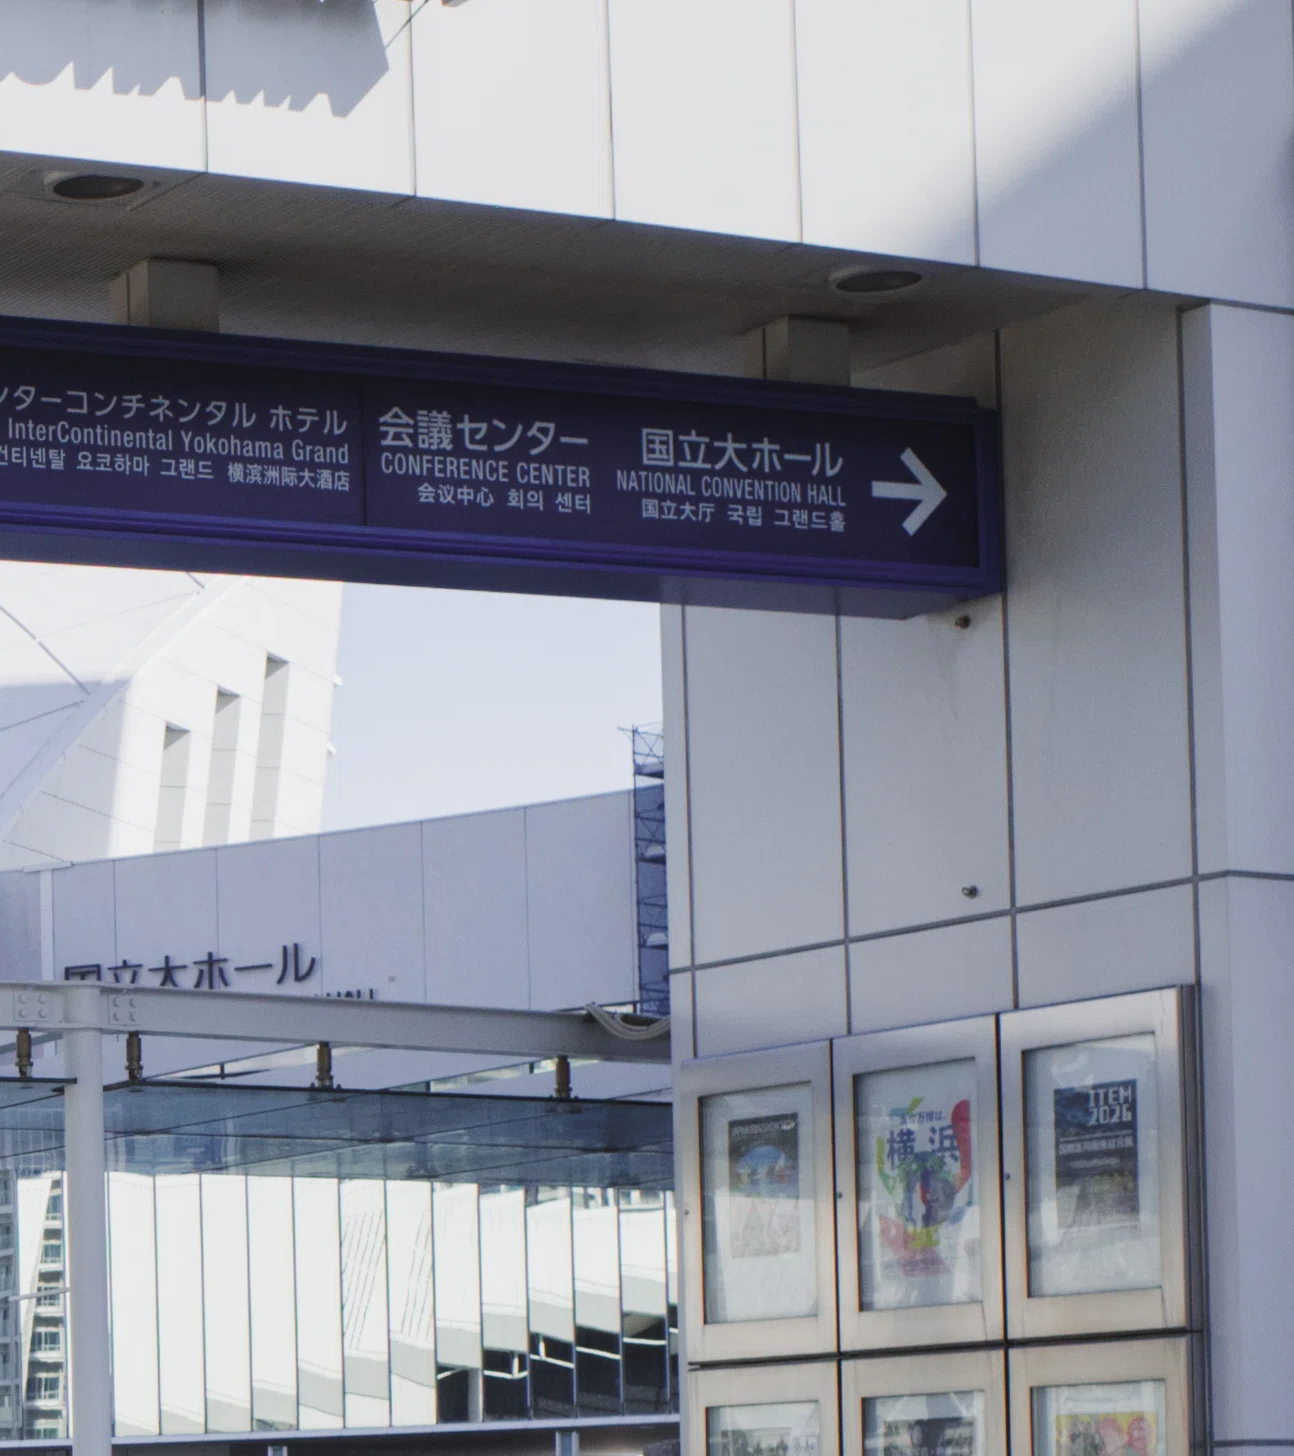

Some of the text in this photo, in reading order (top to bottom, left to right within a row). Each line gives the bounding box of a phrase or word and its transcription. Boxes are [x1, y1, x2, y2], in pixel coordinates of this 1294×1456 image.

[269, 405, 348, 436] ホテル
[379, 406, 588, 456] 会議センター
[8, 417, 349, 465] InterContinental Yokohama Grand
[641, 427, 844, 478] 国立大ホール
[76, 451, 150, 477] 요코하마
[160, 458, 214, 480] 그랜드
[381, 452, 590, 488] CONFERENCE CENTER
[417, 482, 591, 515] 会议中心 회의 센터
[616, 469, 846, 507] NATIONAL CONVENTION HALL
[641, 498, 716, 523] 国立大厅
[1089, 1085, 1132, 1107] ITEM
[1088, 1104, 1133, 1127] 2026
